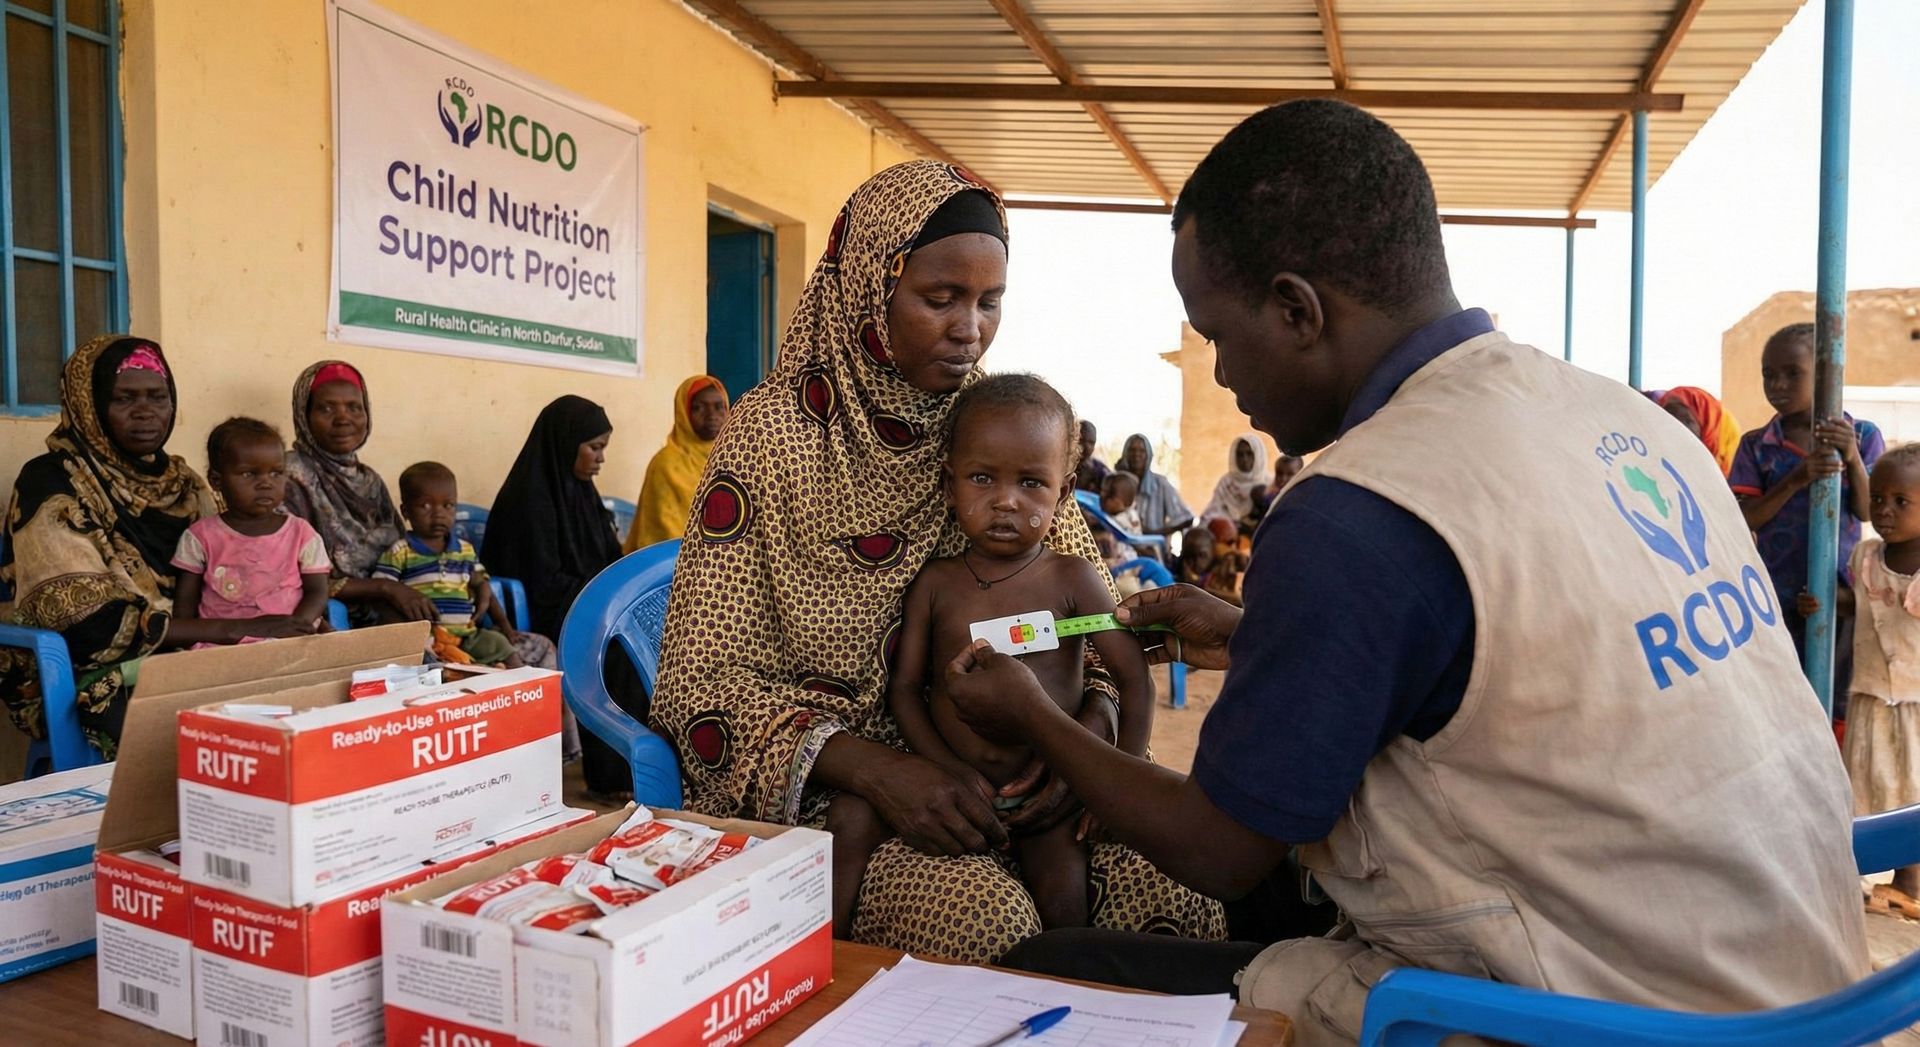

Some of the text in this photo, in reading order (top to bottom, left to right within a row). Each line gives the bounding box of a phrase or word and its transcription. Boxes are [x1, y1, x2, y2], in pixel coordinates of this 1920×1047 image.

[445, 76, 475, 98] RCDO
[486, 103, 577, 172] RCDO
[387, 160, 609, 254] Child Nutrition
[378, 215, 616, 301] Support Project
[395, 307, 604, 351] Rural Health Clinic in North Darfur, Sudan
[1595, 432, 1648, 466] RCDO
[1635, 564, 1776, 690] RCDO
[332, 685, 543, 749] Ready-to-Use Therapeutic Food
[196, 747, 258, 785] RUTF
[412, 721, 488, 769] RUTF
[112, 883, 164, 921] RUTF
[468, 876, 522, 901] RUTF
[212, 917, 275, 957] RUTF
[702, 970, 770, 1041] RUTF
